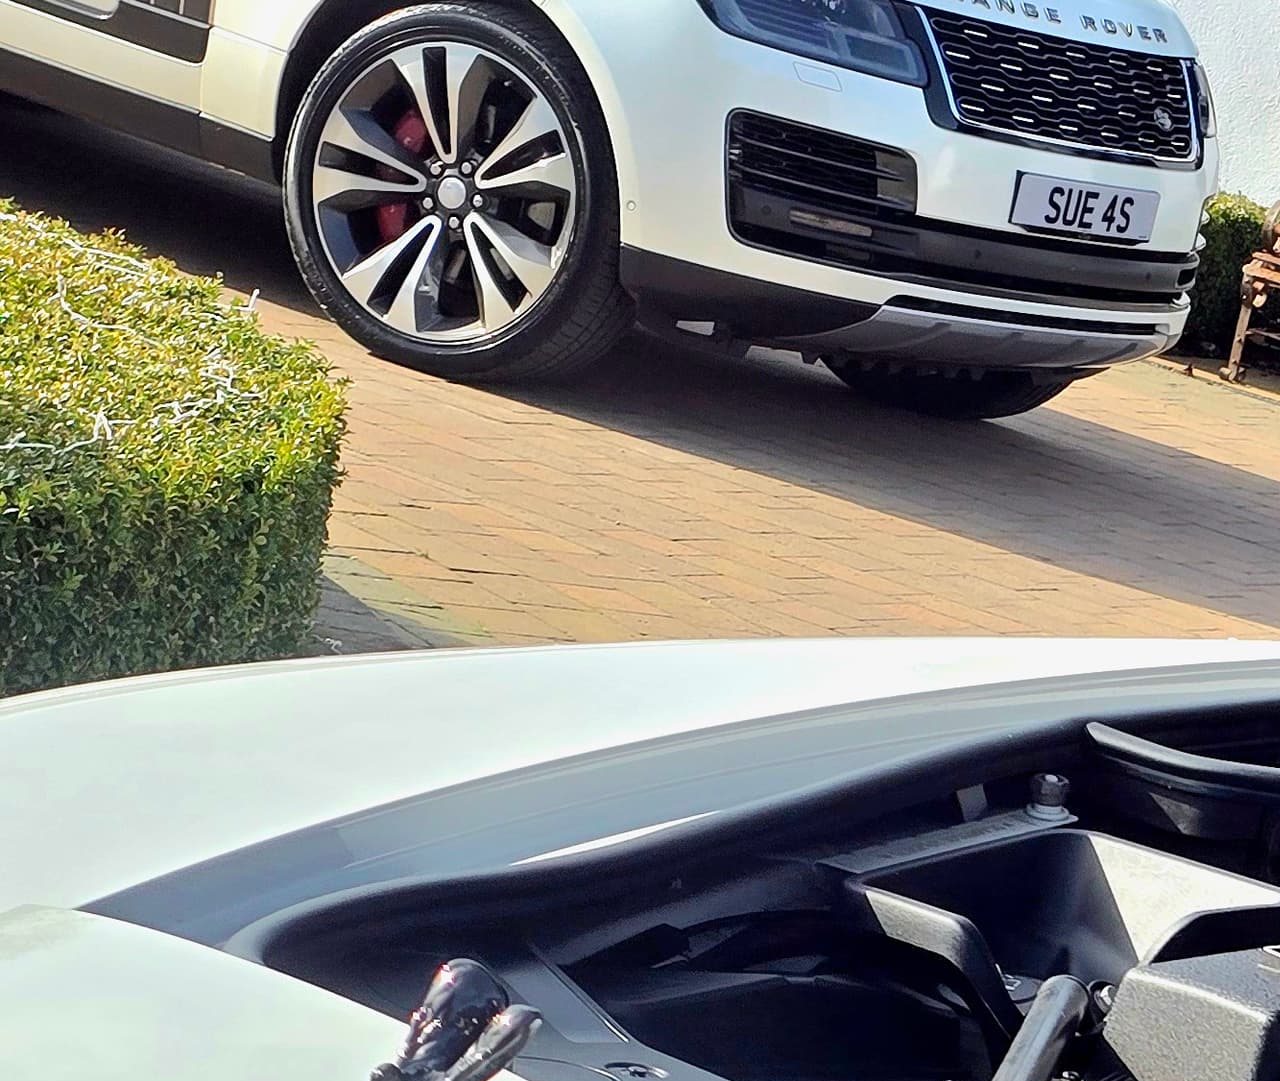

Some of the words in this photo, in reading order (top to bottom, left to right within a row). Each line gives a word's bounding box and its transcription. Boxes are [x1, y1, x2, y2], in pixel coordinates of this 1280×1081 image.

[961, 0, 1062, 24] ANGE
[1080, 15, 1168, 43] ROVER
[1044, 186, 1100, 229] SUE
[1101, 194, 1135, 233] 4S
